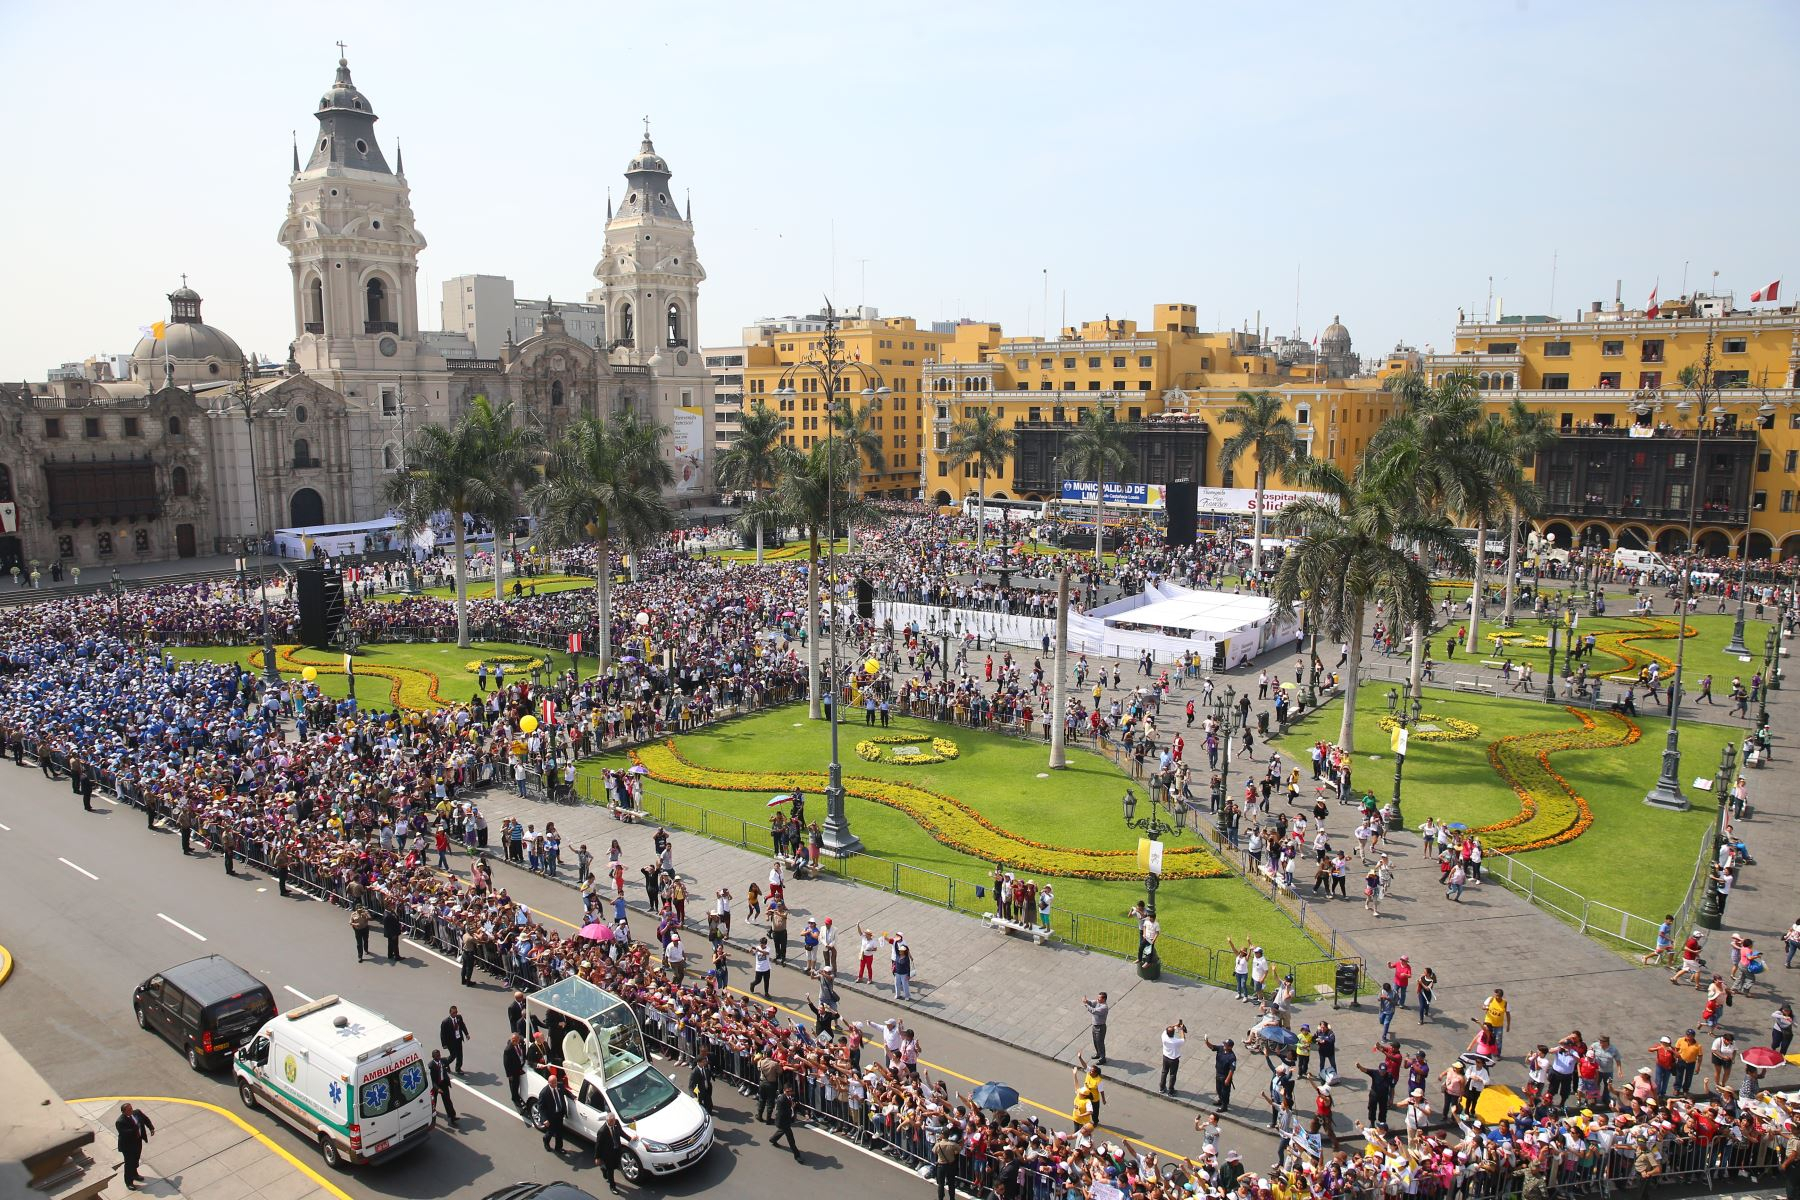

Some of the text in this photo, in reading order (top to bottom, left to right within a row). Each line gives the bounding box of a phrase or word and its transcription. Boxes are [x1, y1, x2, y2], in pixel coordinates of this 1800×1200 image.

[1073, 482, 1145, 494] MUNICPALIDAD DE
[363, 1052, 419, 1083] AMBULANCIA
